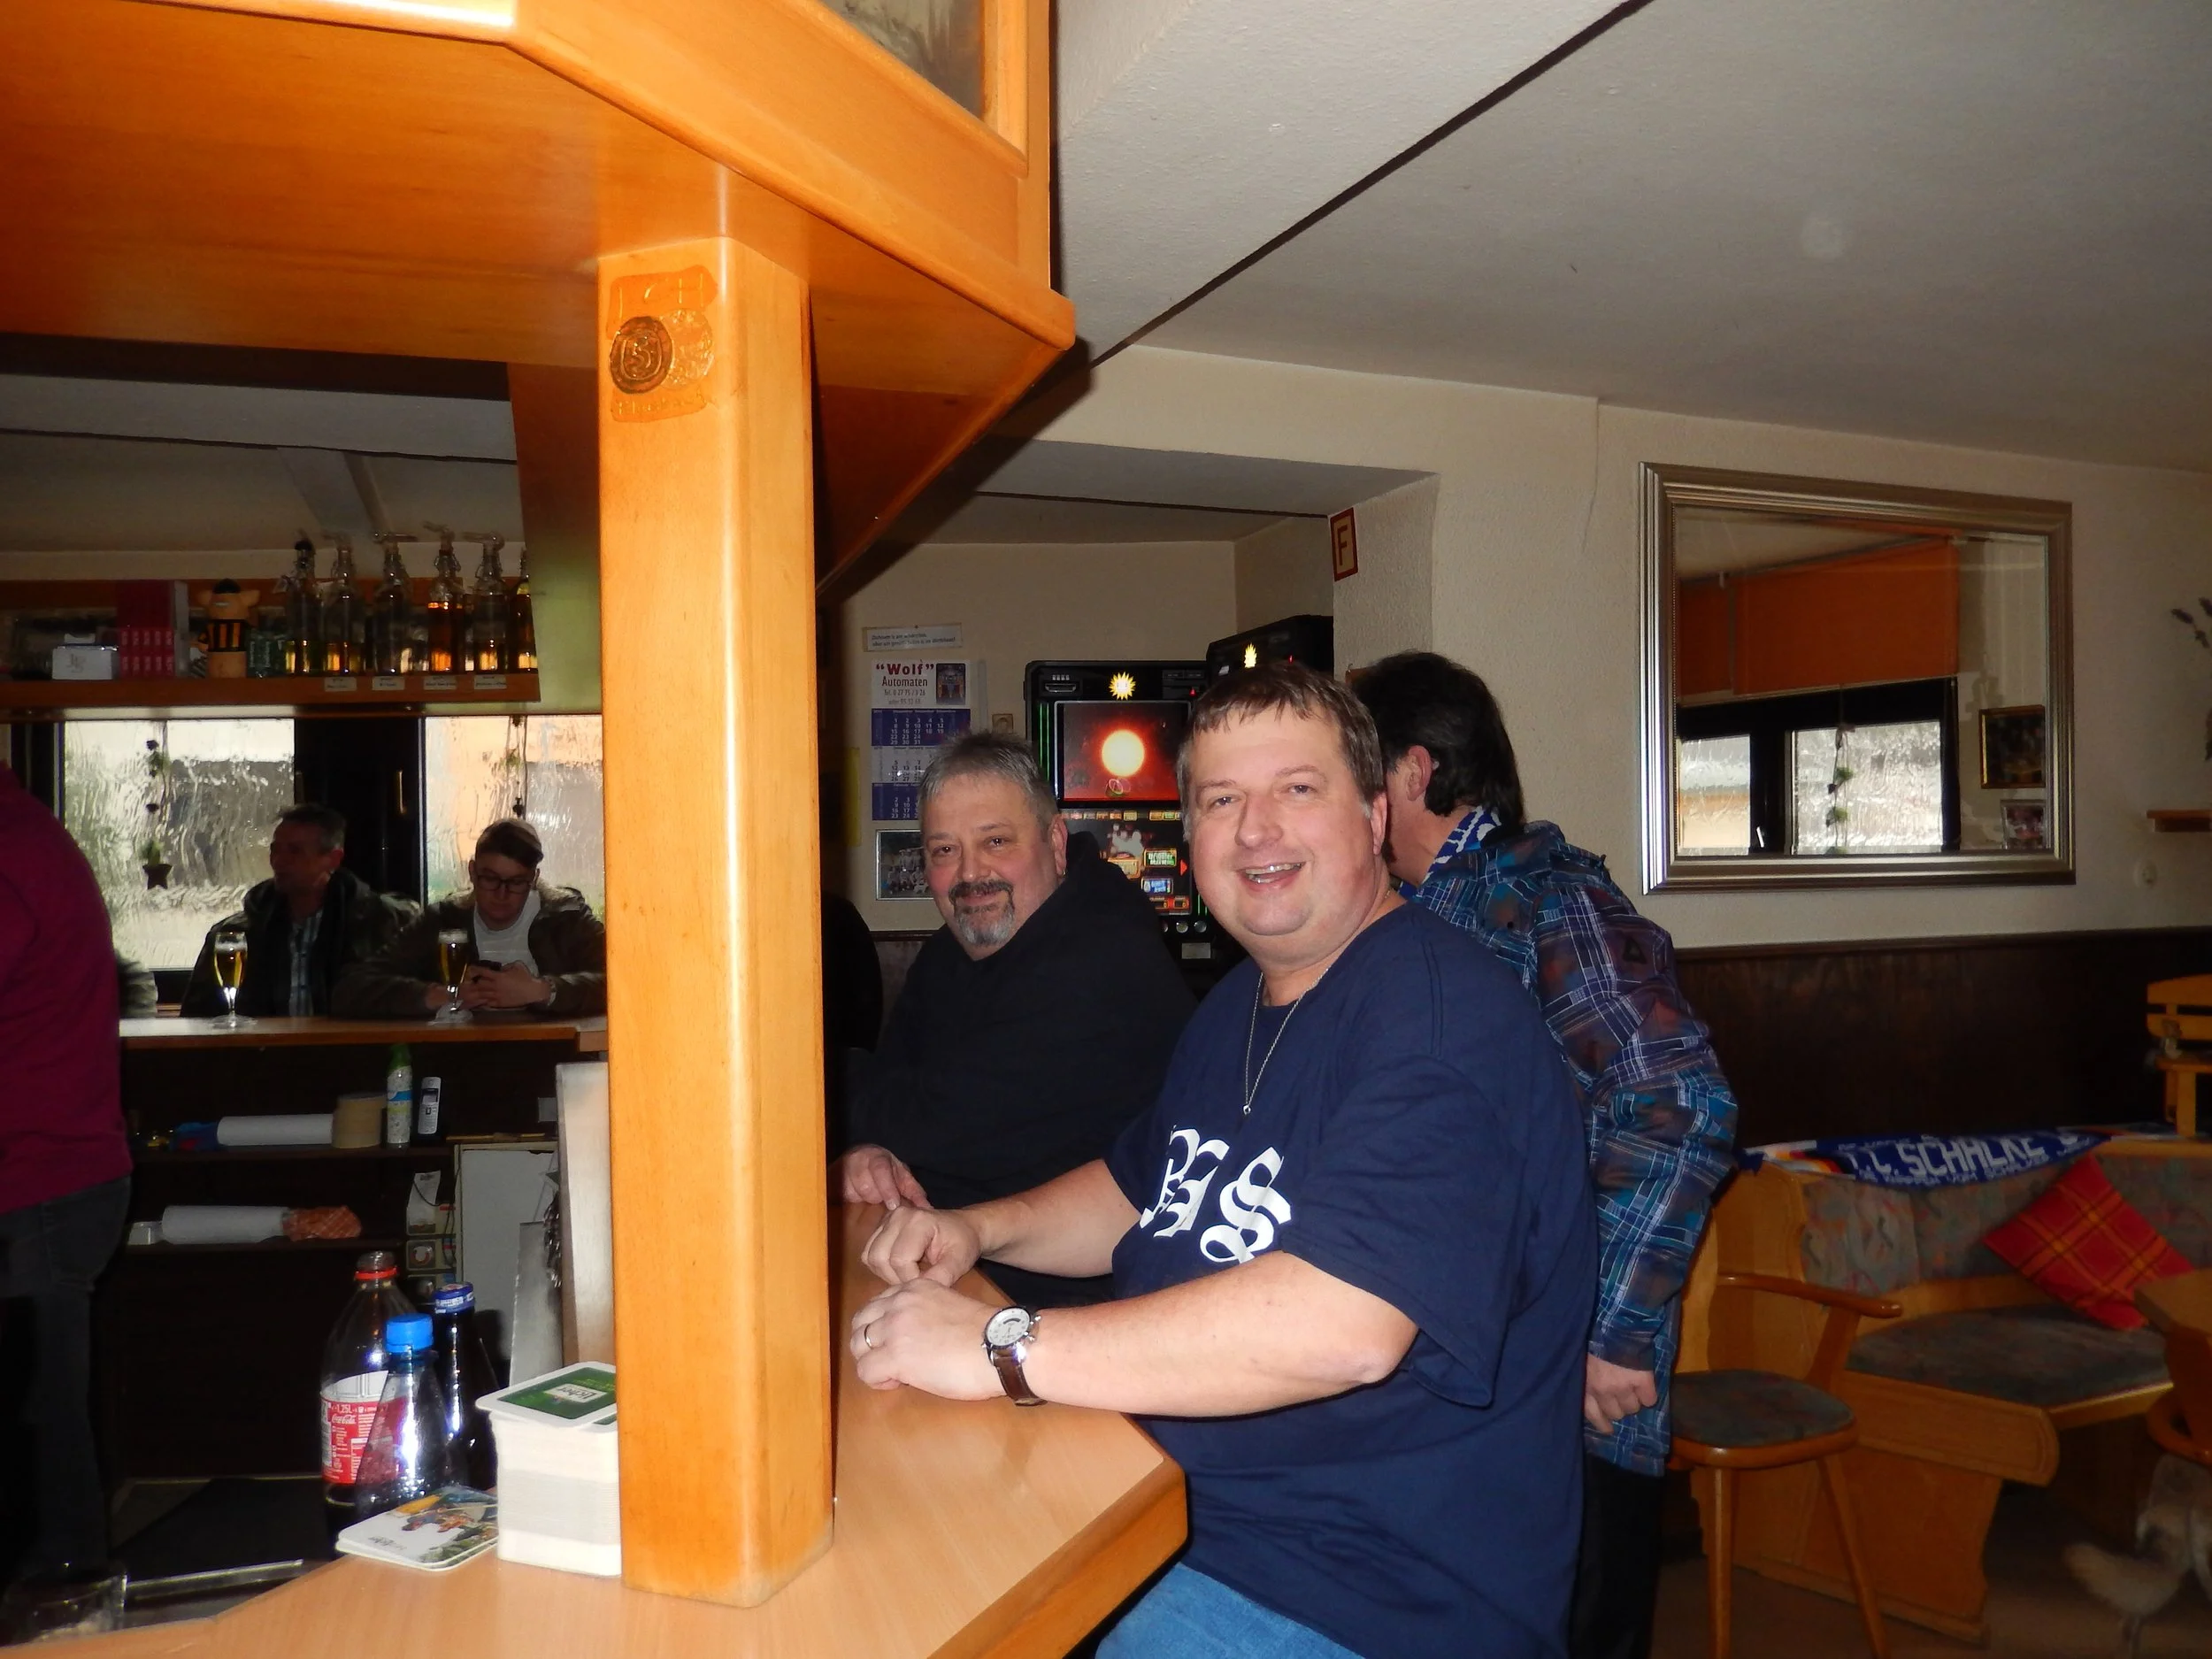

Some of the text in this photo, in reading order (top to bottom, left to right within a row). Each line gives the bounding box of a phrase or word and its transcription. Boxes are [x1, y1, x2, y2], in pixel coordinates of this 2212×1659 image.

[1337, 524, 1348, 566] F
[882, 676, 928, 687] Automaten
[557, 1386, 597, 1401] Licher
